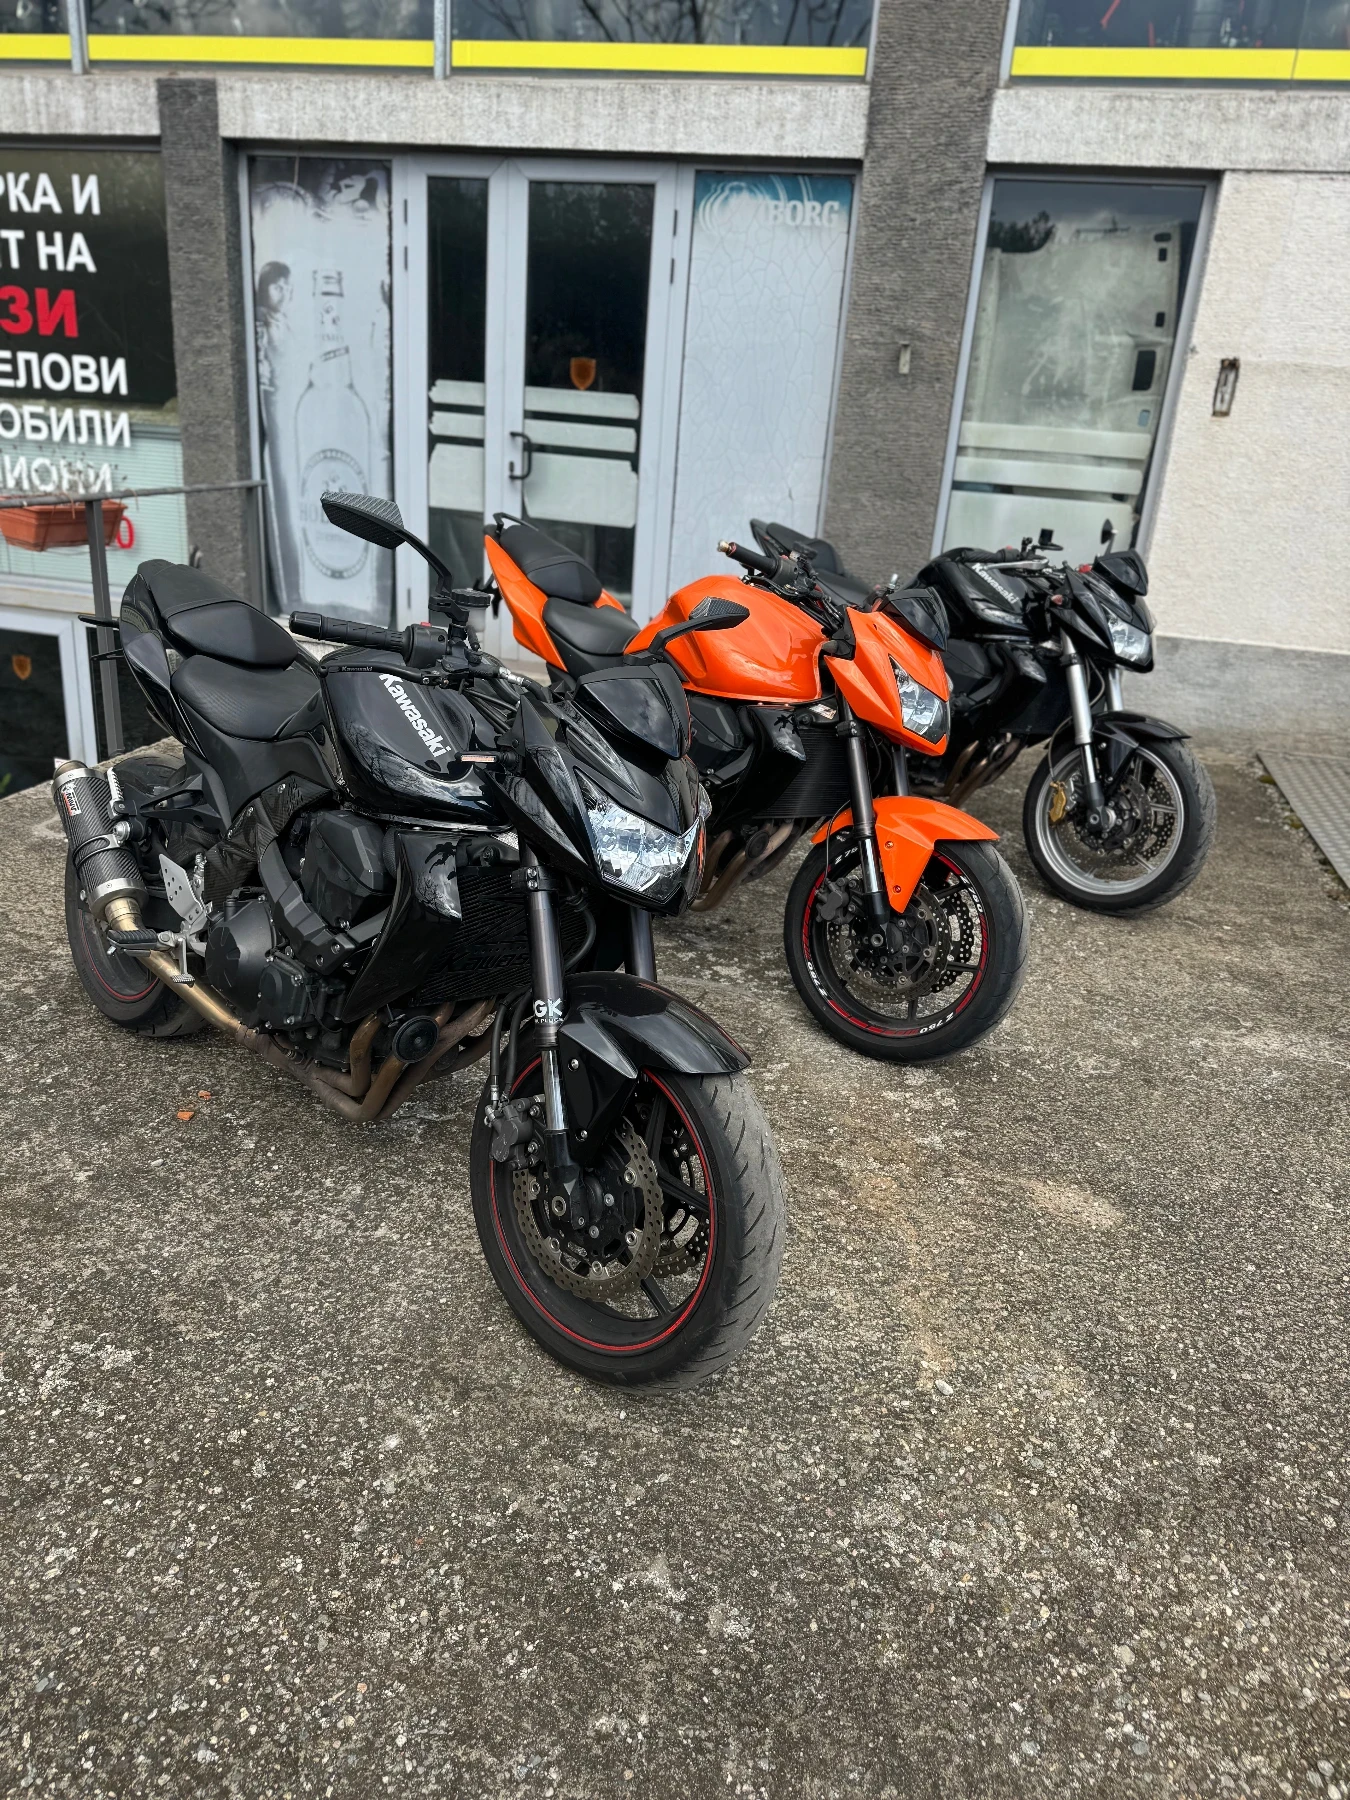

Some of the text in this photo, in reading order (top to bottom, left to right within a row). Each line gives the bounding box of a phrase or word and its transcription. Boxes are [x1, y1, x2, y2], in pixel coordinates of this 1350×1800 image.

[71, 173, 101, 215] И
[762, 199, 840, 228] BORG
[0, 228, 97, 273] Т НА
[0, 402, 131, 448] ОБИЛИ
[0, 454, 113, 494] ИОНИ
[972, 563, 1019, 604] Kawasaki
[379, 673, 451, 758] Kawasaki
[534, 997, 563, 1018] GK
